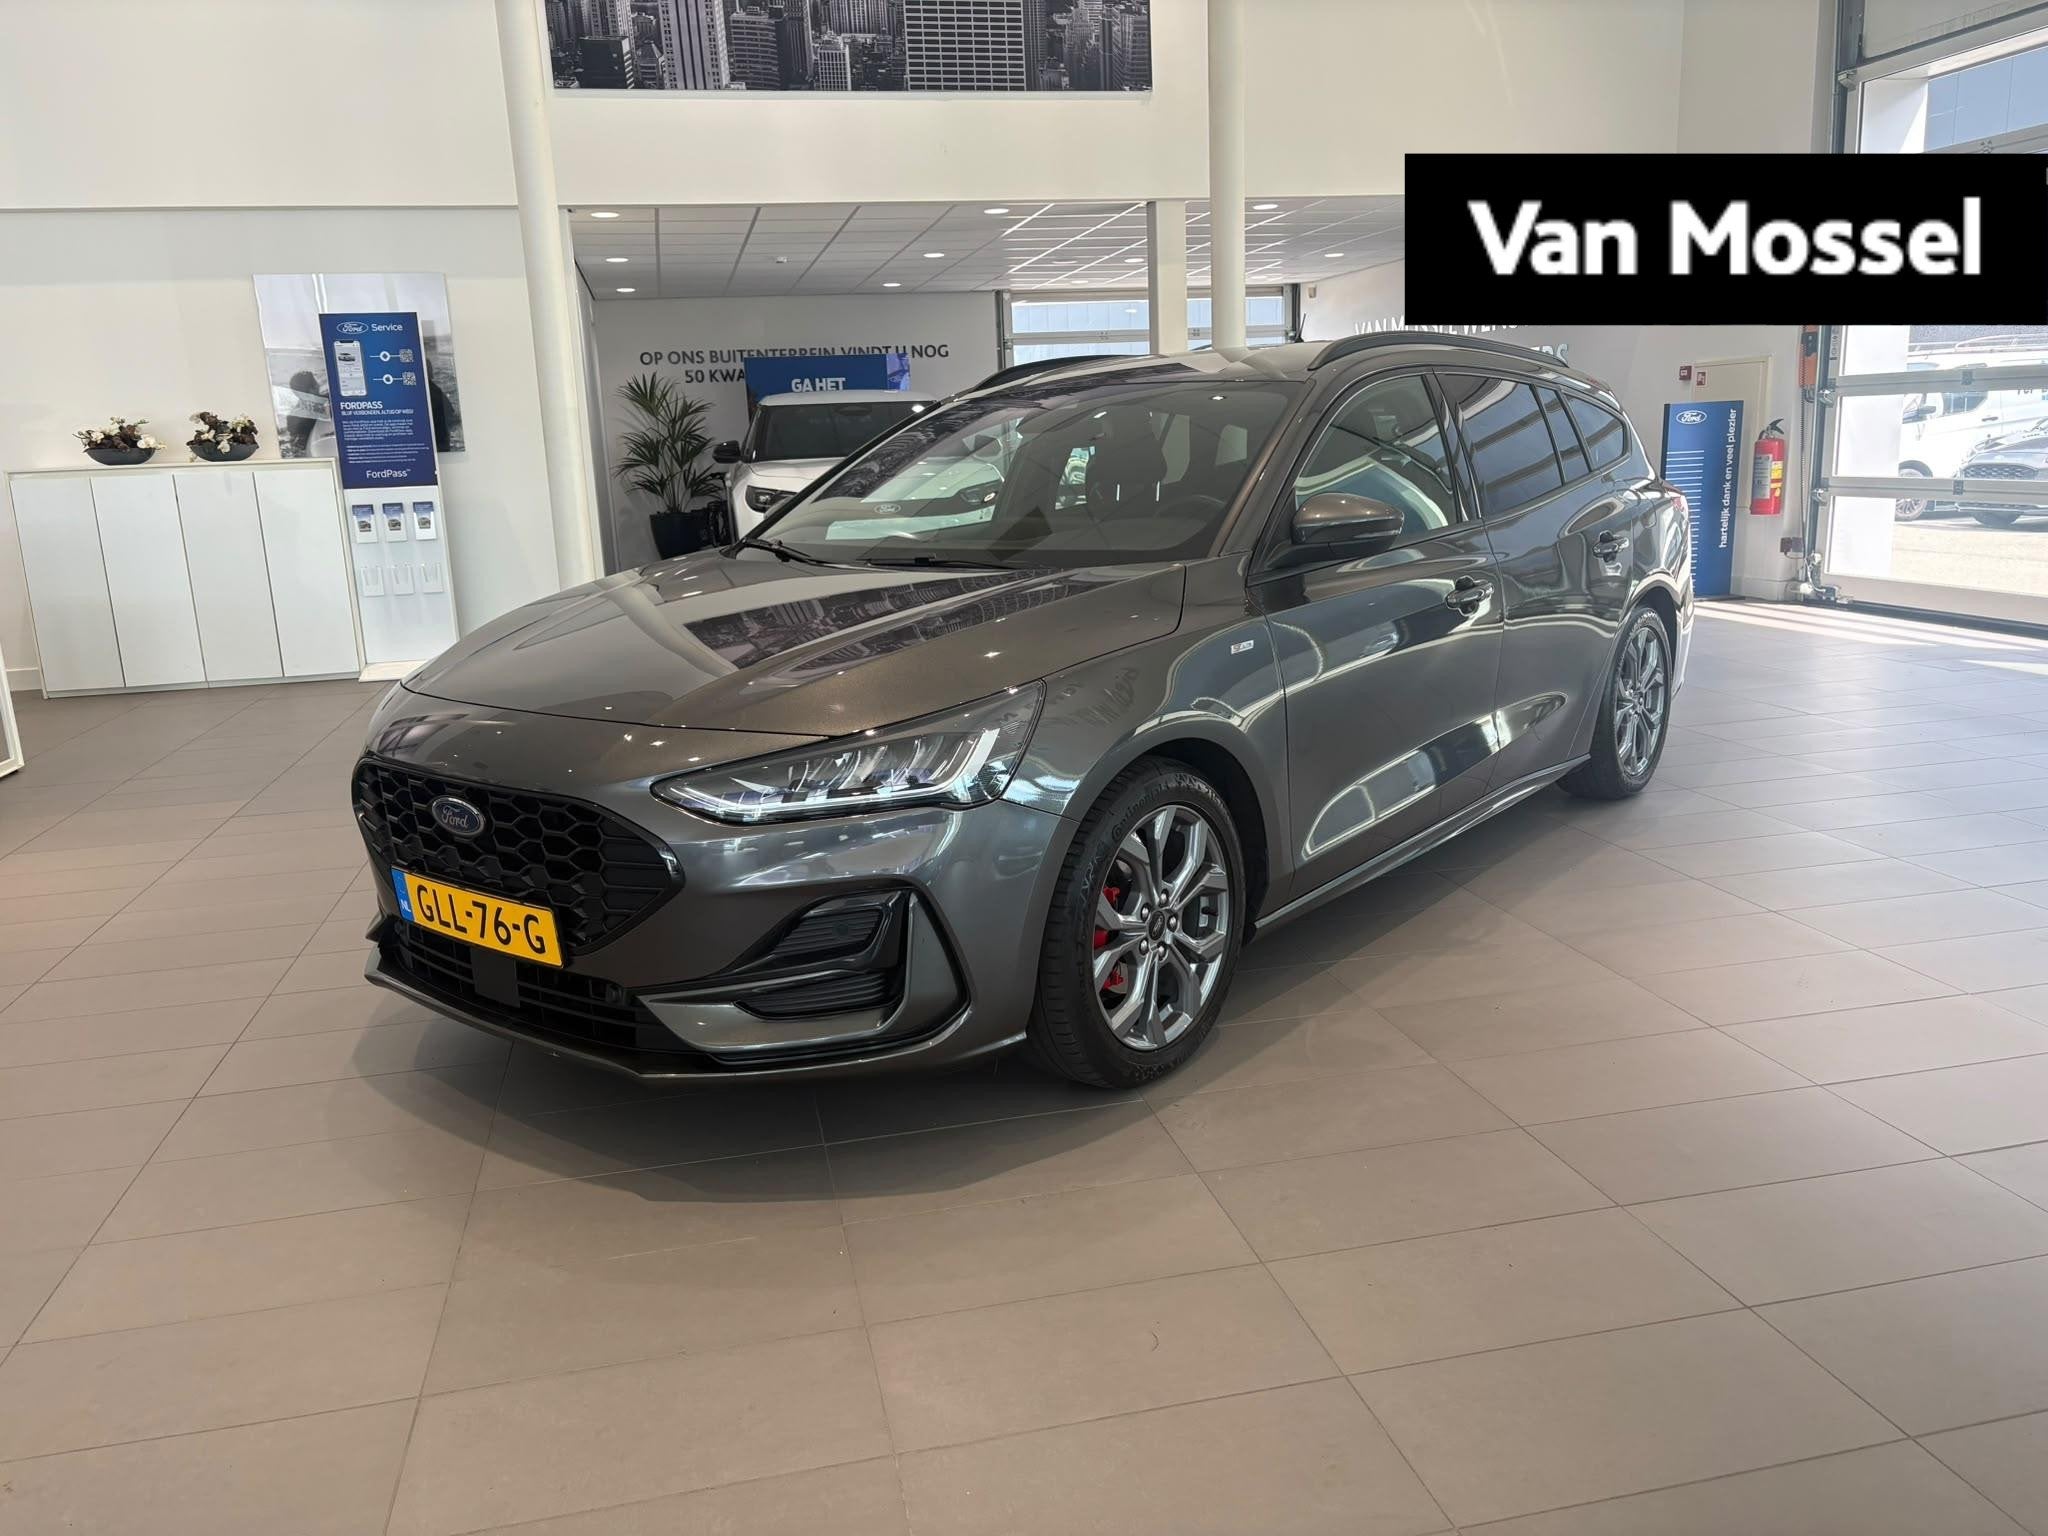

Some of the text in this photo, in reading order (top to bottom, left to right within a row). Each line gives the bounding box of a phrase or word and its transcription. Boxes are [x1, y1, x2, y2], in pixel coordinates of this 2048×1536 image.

[340, 322, 404, 333] Ford Service
[640, 352, 663, 366] OP
[667, 350, 705, 365] ONS
[911, 344, 949, 359] NOG
[685, 369, 705, 384] 50
[791, 377, 846, 392] GA HET
[340, 401, 383, 410] FORDPASS
[1678, 410, 1704, 424] Ford
[1719, 409, 1737, 548] hartelijk dank en veel plezier
[416, 884, 547, 955] GLL-76-G
